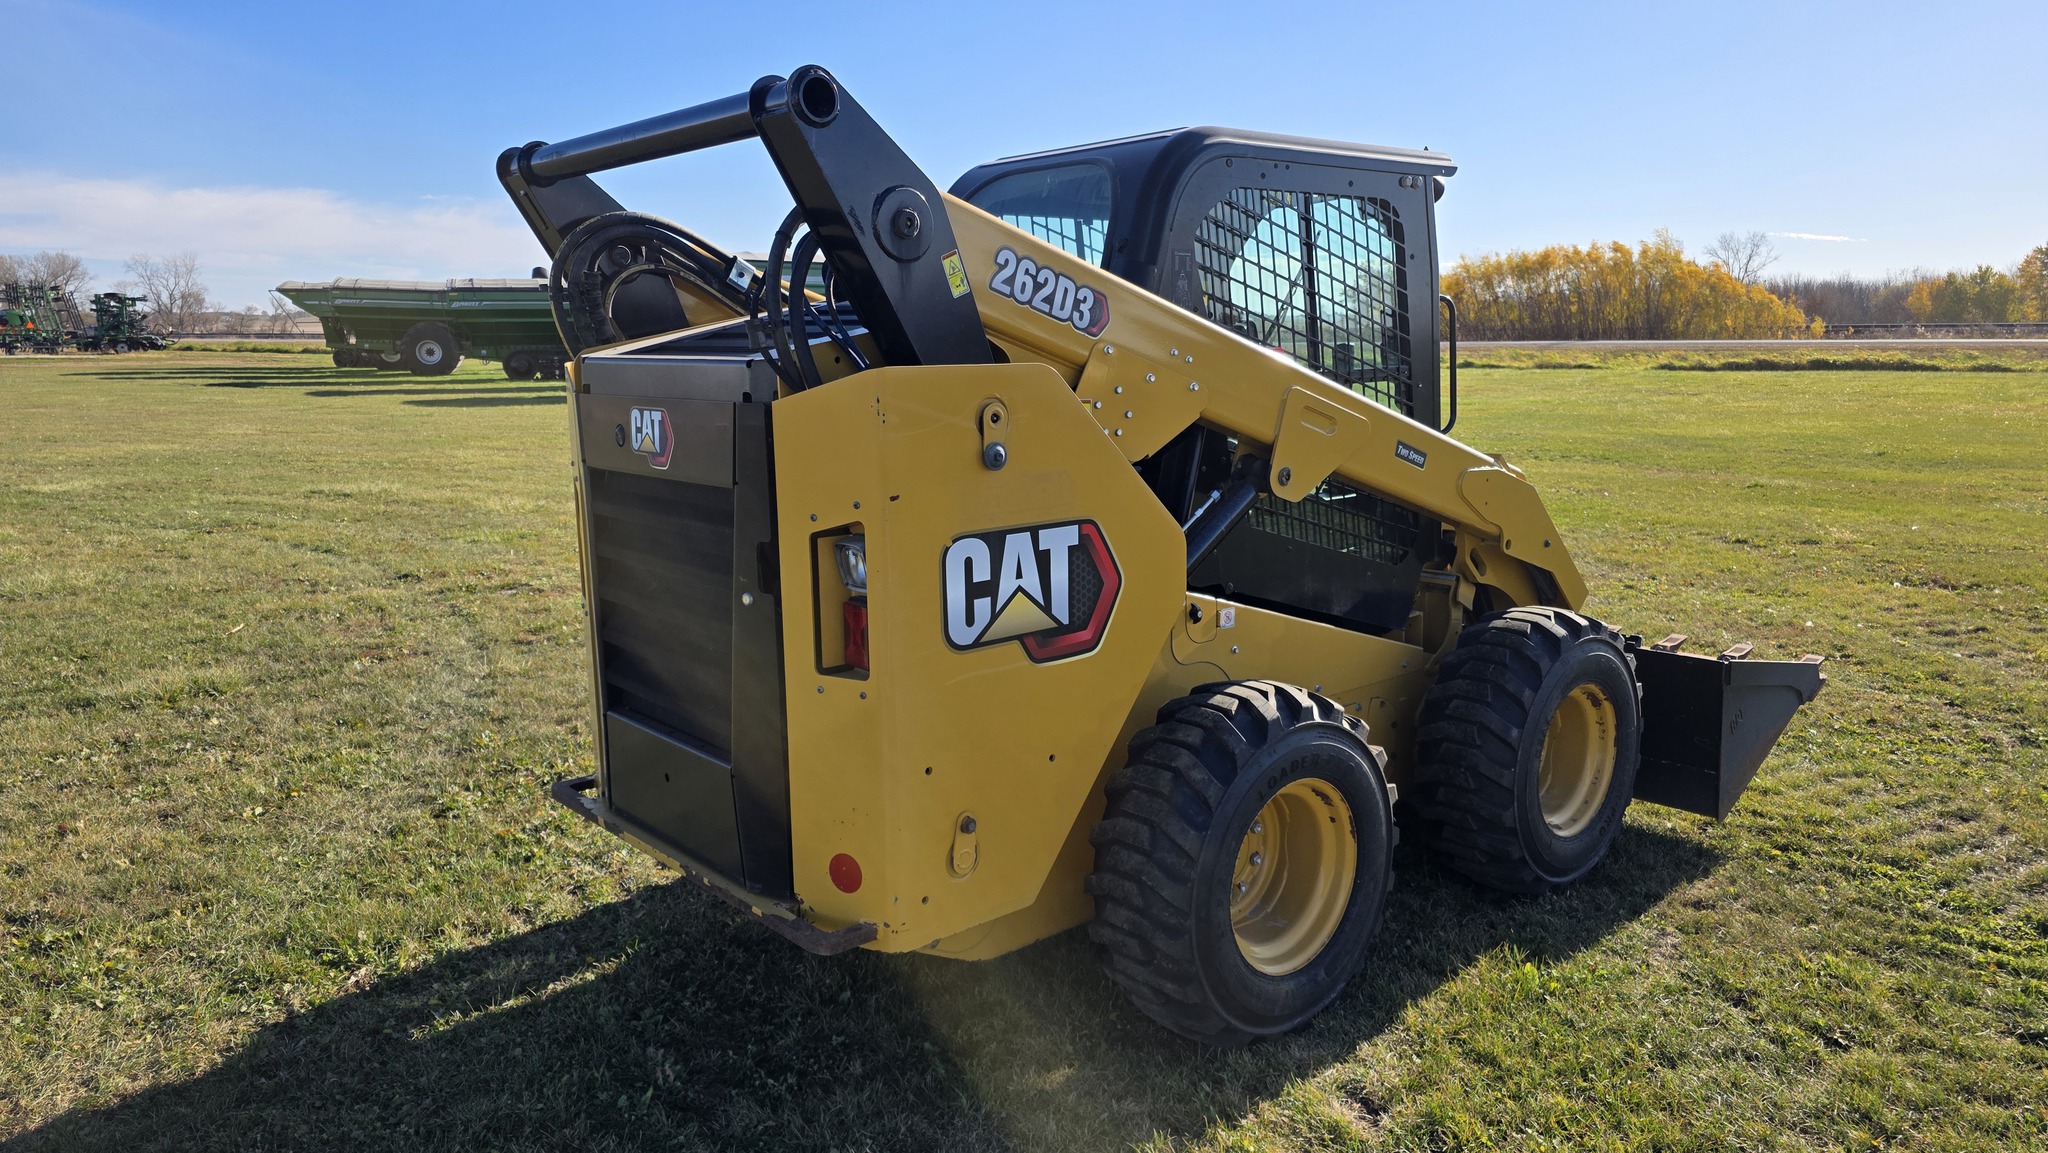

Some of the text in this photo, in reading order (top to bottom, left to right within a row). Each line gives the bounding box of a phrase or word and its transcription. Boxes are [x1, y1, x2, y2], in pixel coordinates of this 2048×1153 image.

[991, 249, 1095, 329] 262D3
[630, 408, 662, 453] CAT
[945, 524, 1079, 646] CAT
